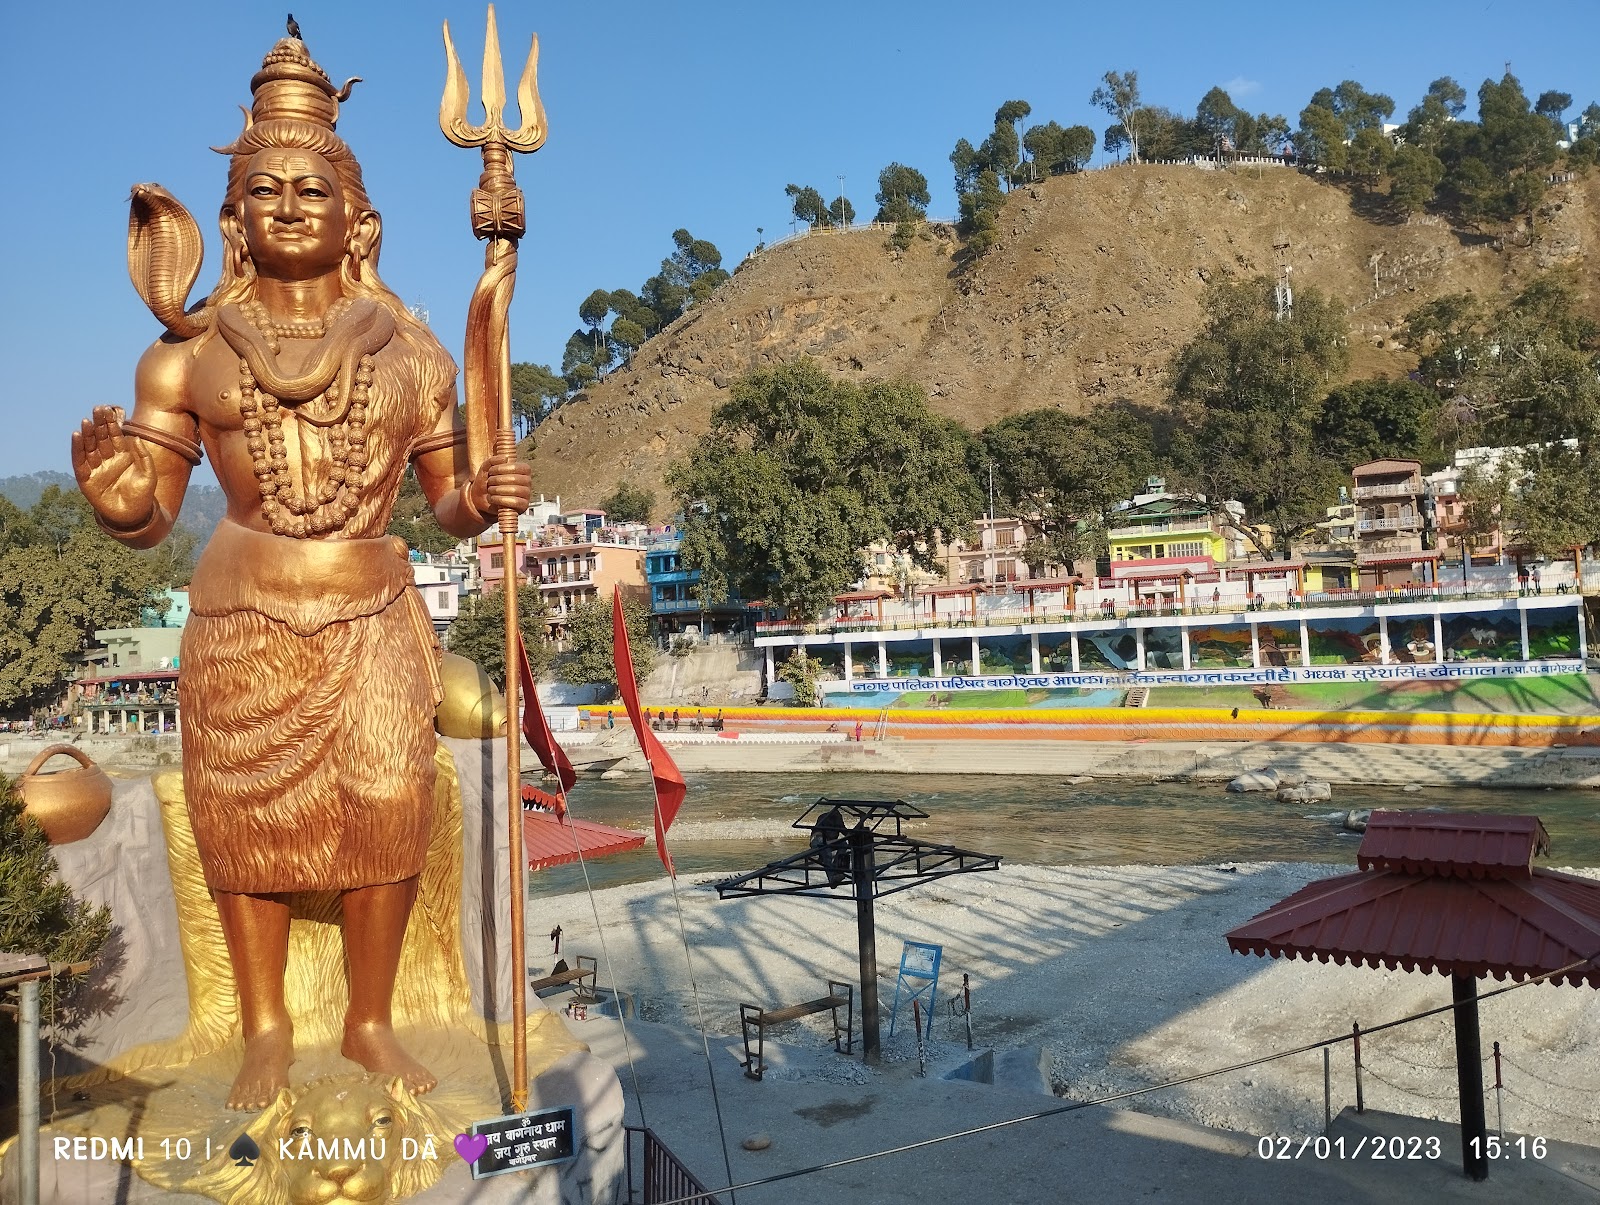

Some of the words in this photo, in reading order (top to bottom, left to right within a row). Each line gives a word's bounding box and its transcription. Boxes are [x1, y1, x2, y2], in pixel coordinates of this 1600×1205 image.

[892, 678, 939, 691] पालिका
[942, 676, 985, 689] परिषद
[987, 675, 1049, 688] बागेश्वर
[1053, 675, 1103, 686] आपका
[1351, 665, 1393, 682] सुरेश
[1395, 665, 1427, 678] सिंह
[1428, 663, 1496, 677] खेतवाल
[521, 1117, 531, 1128] ॐ
[545, 1119, 566, 1134] धाम
[493, 1146, 512, 1160] जय
